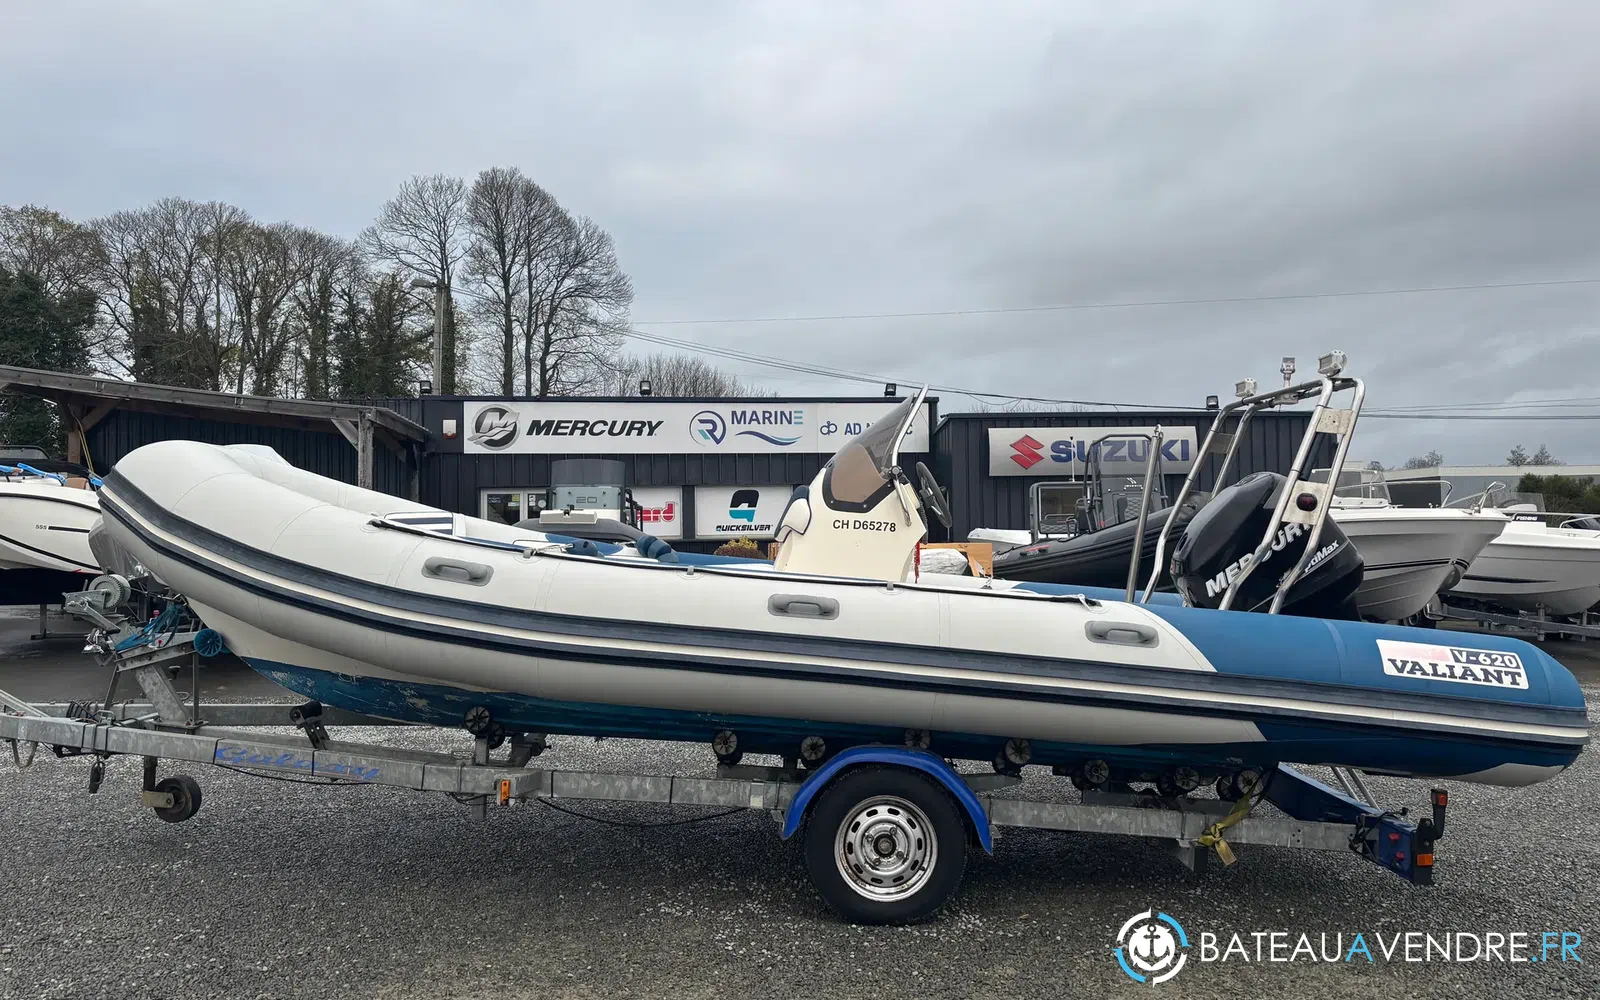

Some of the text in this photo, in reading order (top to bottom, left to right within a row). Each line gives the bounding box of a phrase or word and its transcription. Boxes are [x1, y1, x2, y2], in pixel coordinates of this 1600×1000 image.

[731, 410, 804, 425] MARINE
[526, 419, 664, 437] MERCURY
[844, 422, 862, 436] AD
[1050, 439, 1190, 463] SUZUKI
[715, 524, 773, 532] QUICKSILVER
[832, 519, 897, 532] CH D65278
[1452, 650, 1518, 668] V-620
[1387, 658, 1522, 686] VALIANT
